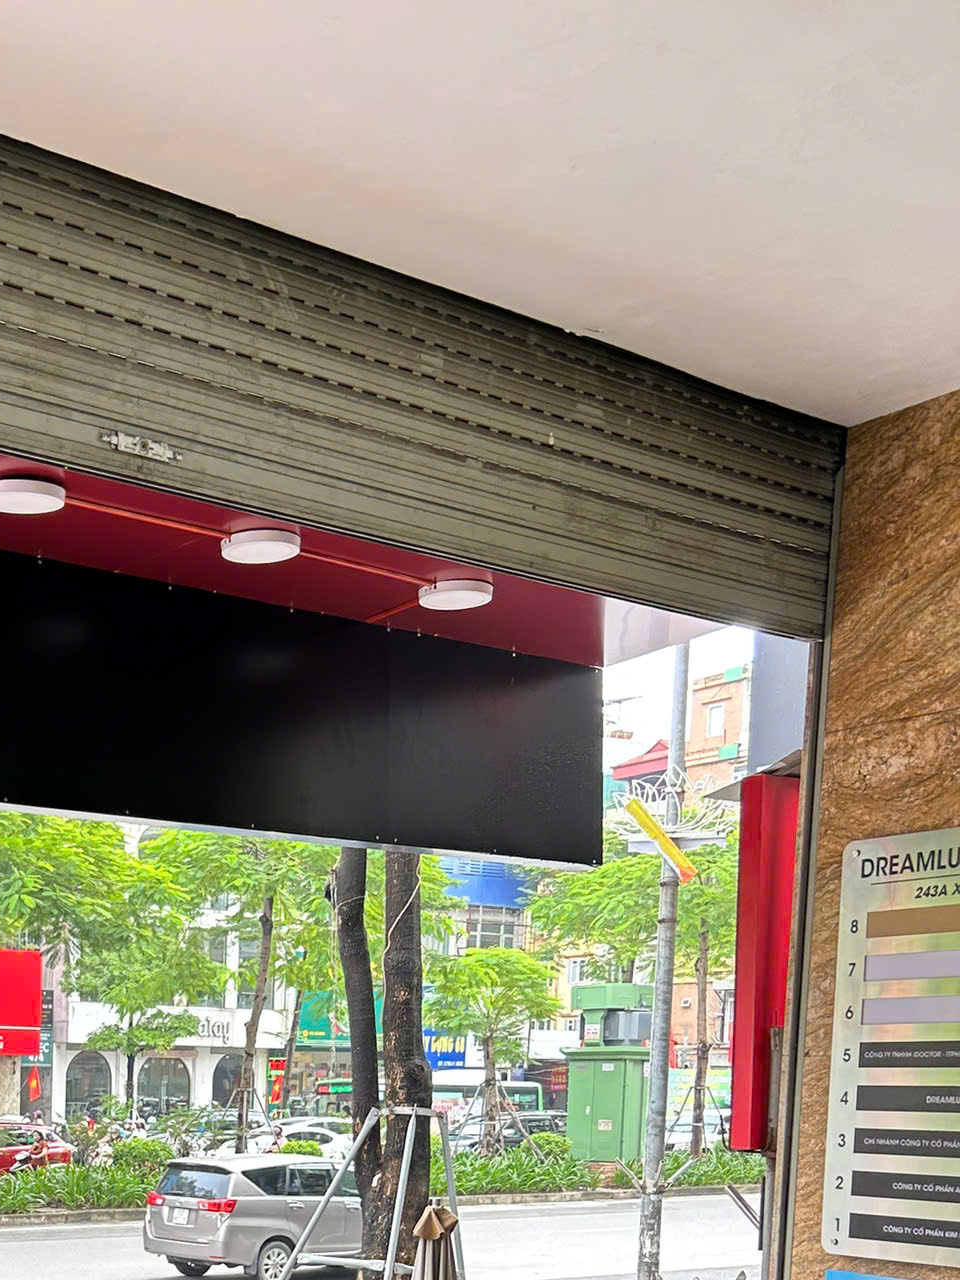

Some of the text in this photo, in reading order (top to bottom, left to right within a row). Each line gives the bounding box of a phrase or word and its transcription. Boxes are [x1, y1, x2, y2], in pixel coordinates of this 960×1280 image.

[914, 884, 948, 899] 243A
[850, 919, 859, 934] 8
[848, 962, 857, 977] 7
[844, 1005, 854, 1020] 6
[842, 1048, 852, 1063] 5
[840, 1091, 849, 1105] 4
[837, 1133, 846, 1148] 3
[921, 1139, 929, 1147] TY
[835, 1175, 844, 1190] 2
[835, 1217, 840, 1232] 1
